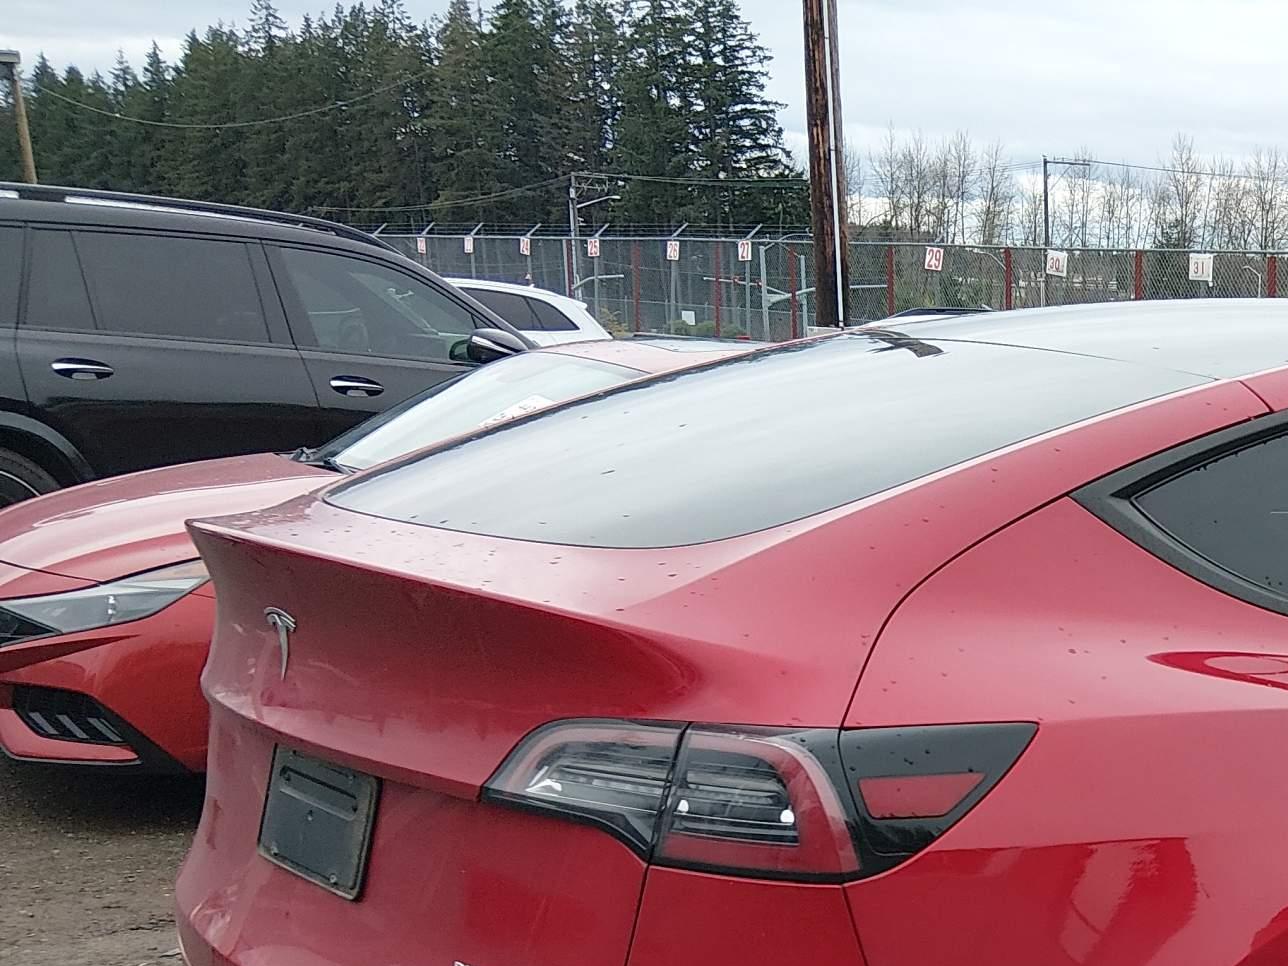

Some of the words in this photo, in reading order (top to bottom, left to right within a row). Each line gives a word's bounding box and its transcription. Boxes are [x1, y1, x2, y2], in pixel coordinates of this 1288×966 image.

[521, 238, 529, 253] 24
[589, 239, 598, 255] 25
[668, 242, 678, 259] 26
[740, 241, 750, 259] 27
[927, 248, 942, 269] 29
[1049, 257, 1060, 271] 30
[1193, 261, 1205, 274] 31
